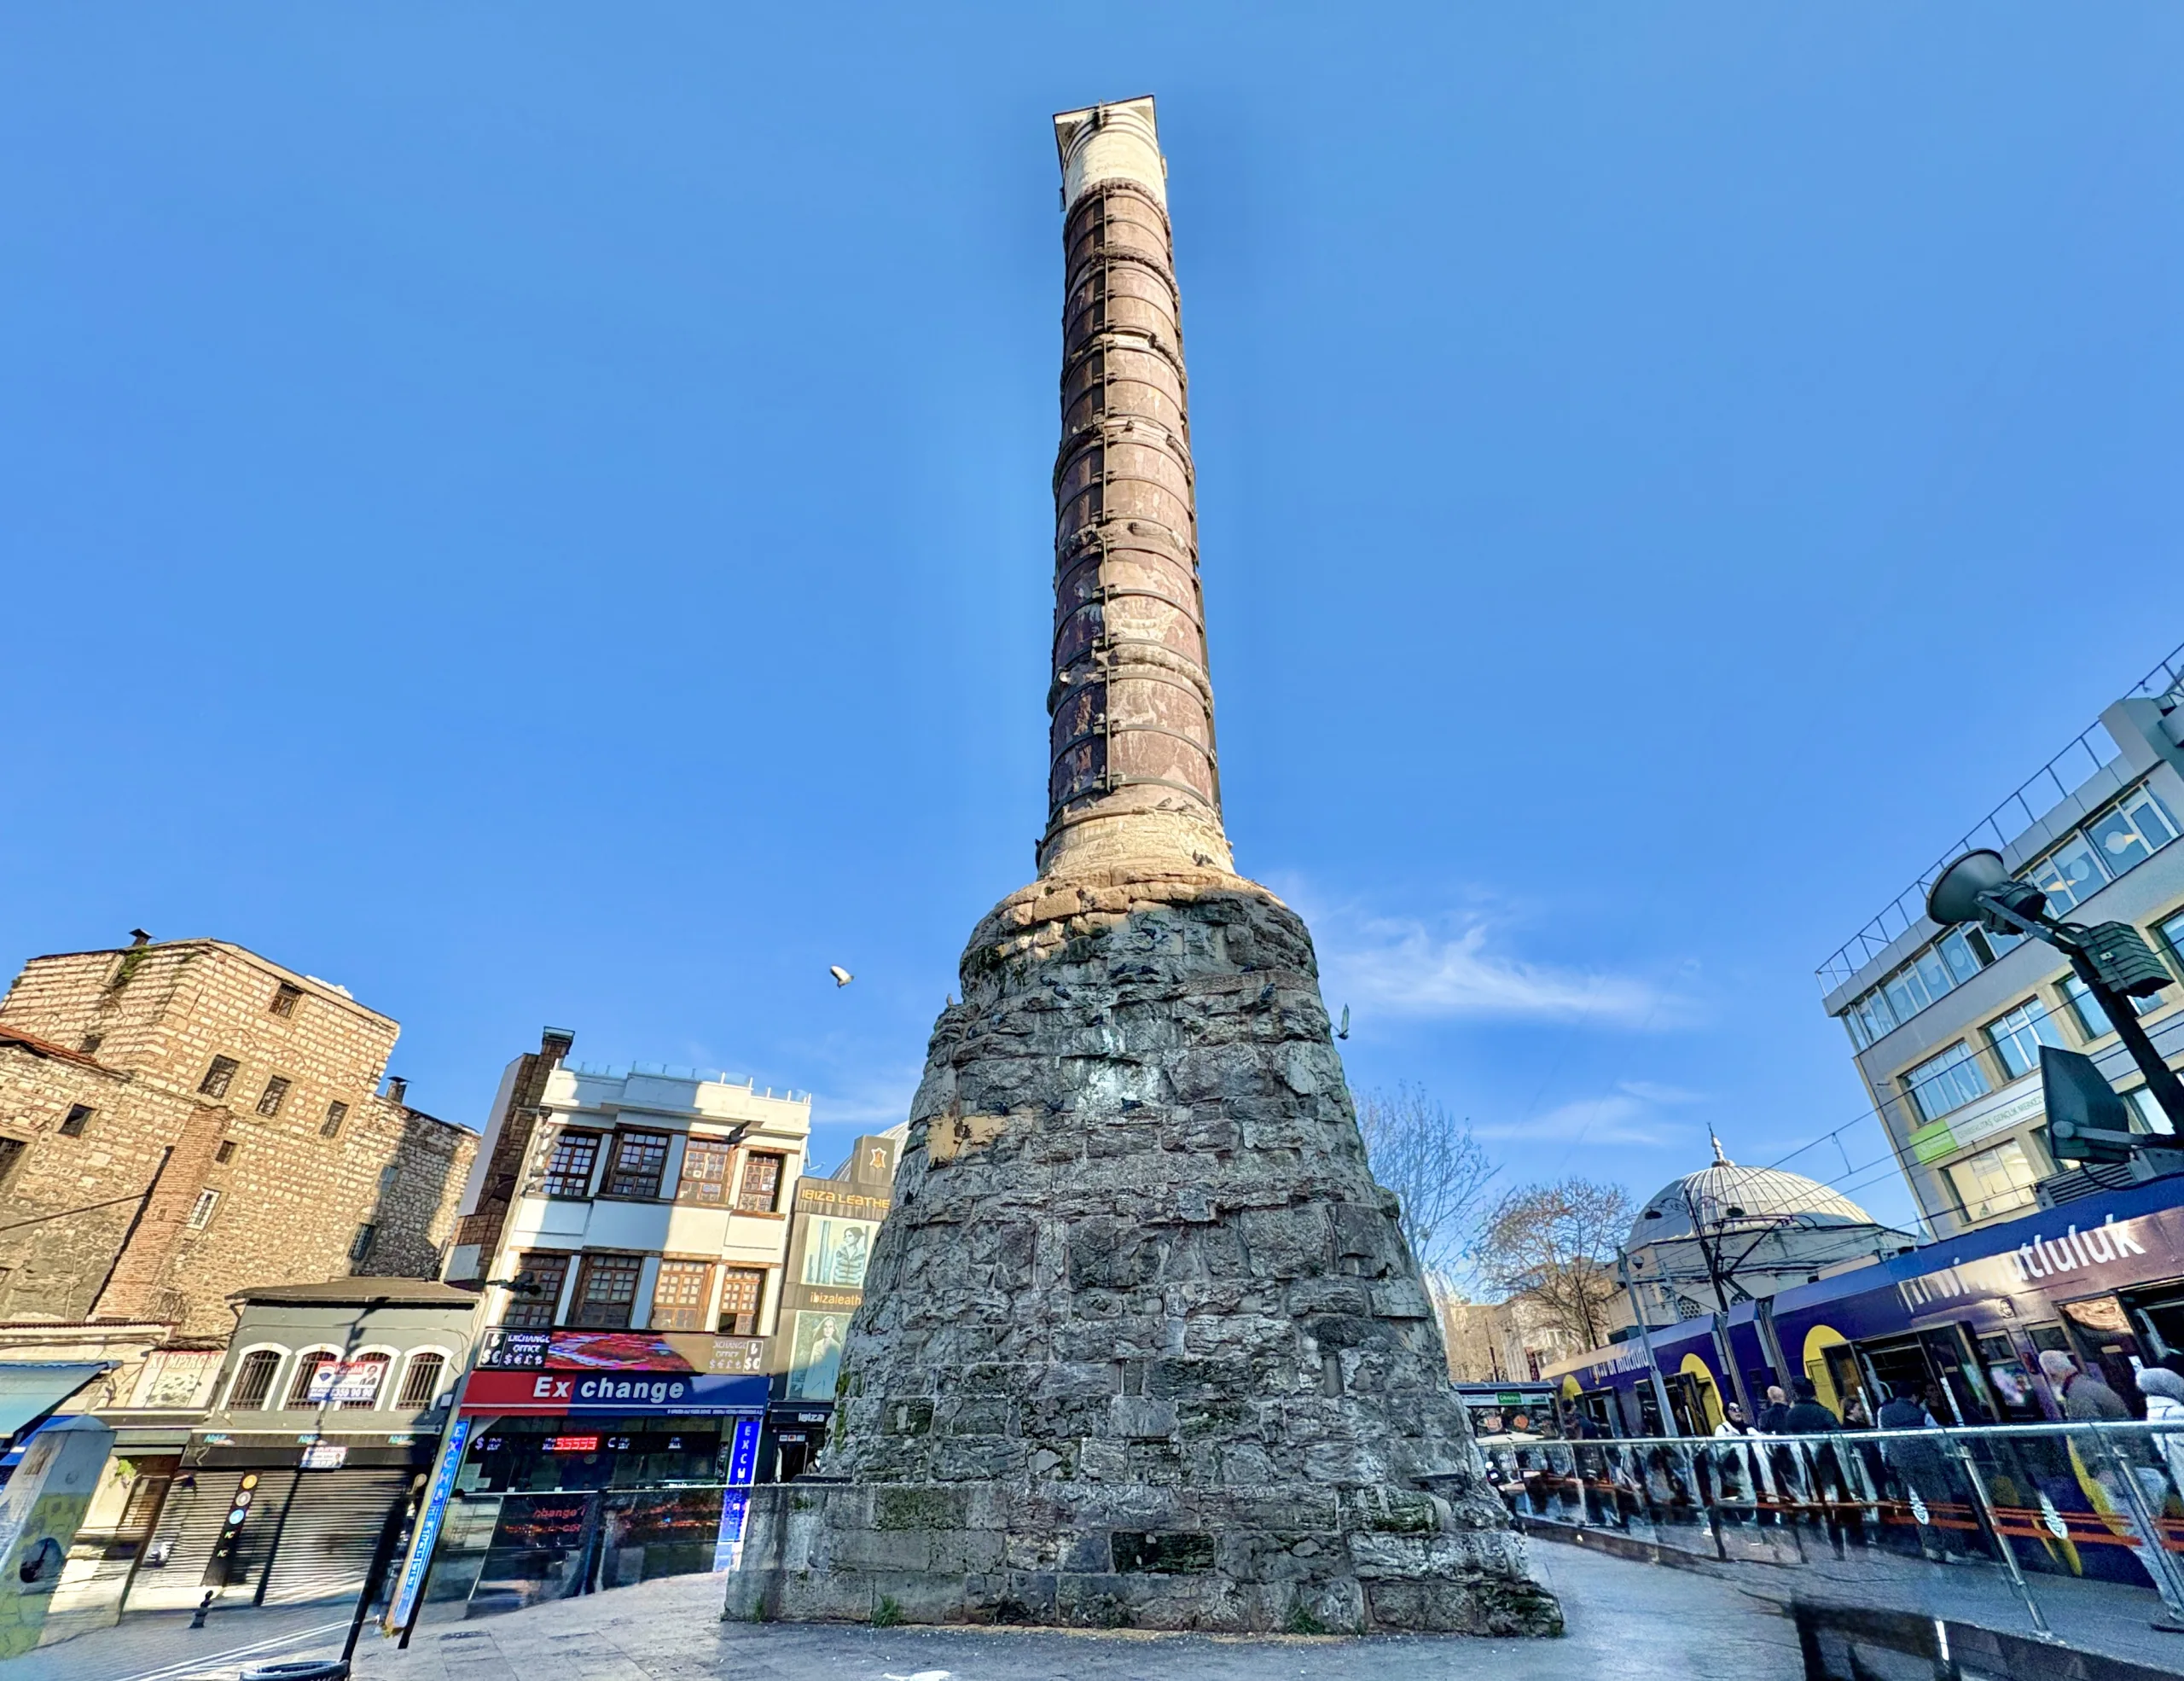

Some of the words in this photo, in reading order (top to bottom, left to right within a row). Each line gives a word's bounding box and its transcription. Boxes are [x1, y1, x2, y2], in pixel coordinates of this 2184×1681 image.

[1975, 1213, 2146, 1290] utluluk
[810, 1292, 862, 1306] ibizaleath
[533, 1376, 571, 1398] Ex
[580, 1377, 684, 1404] change
